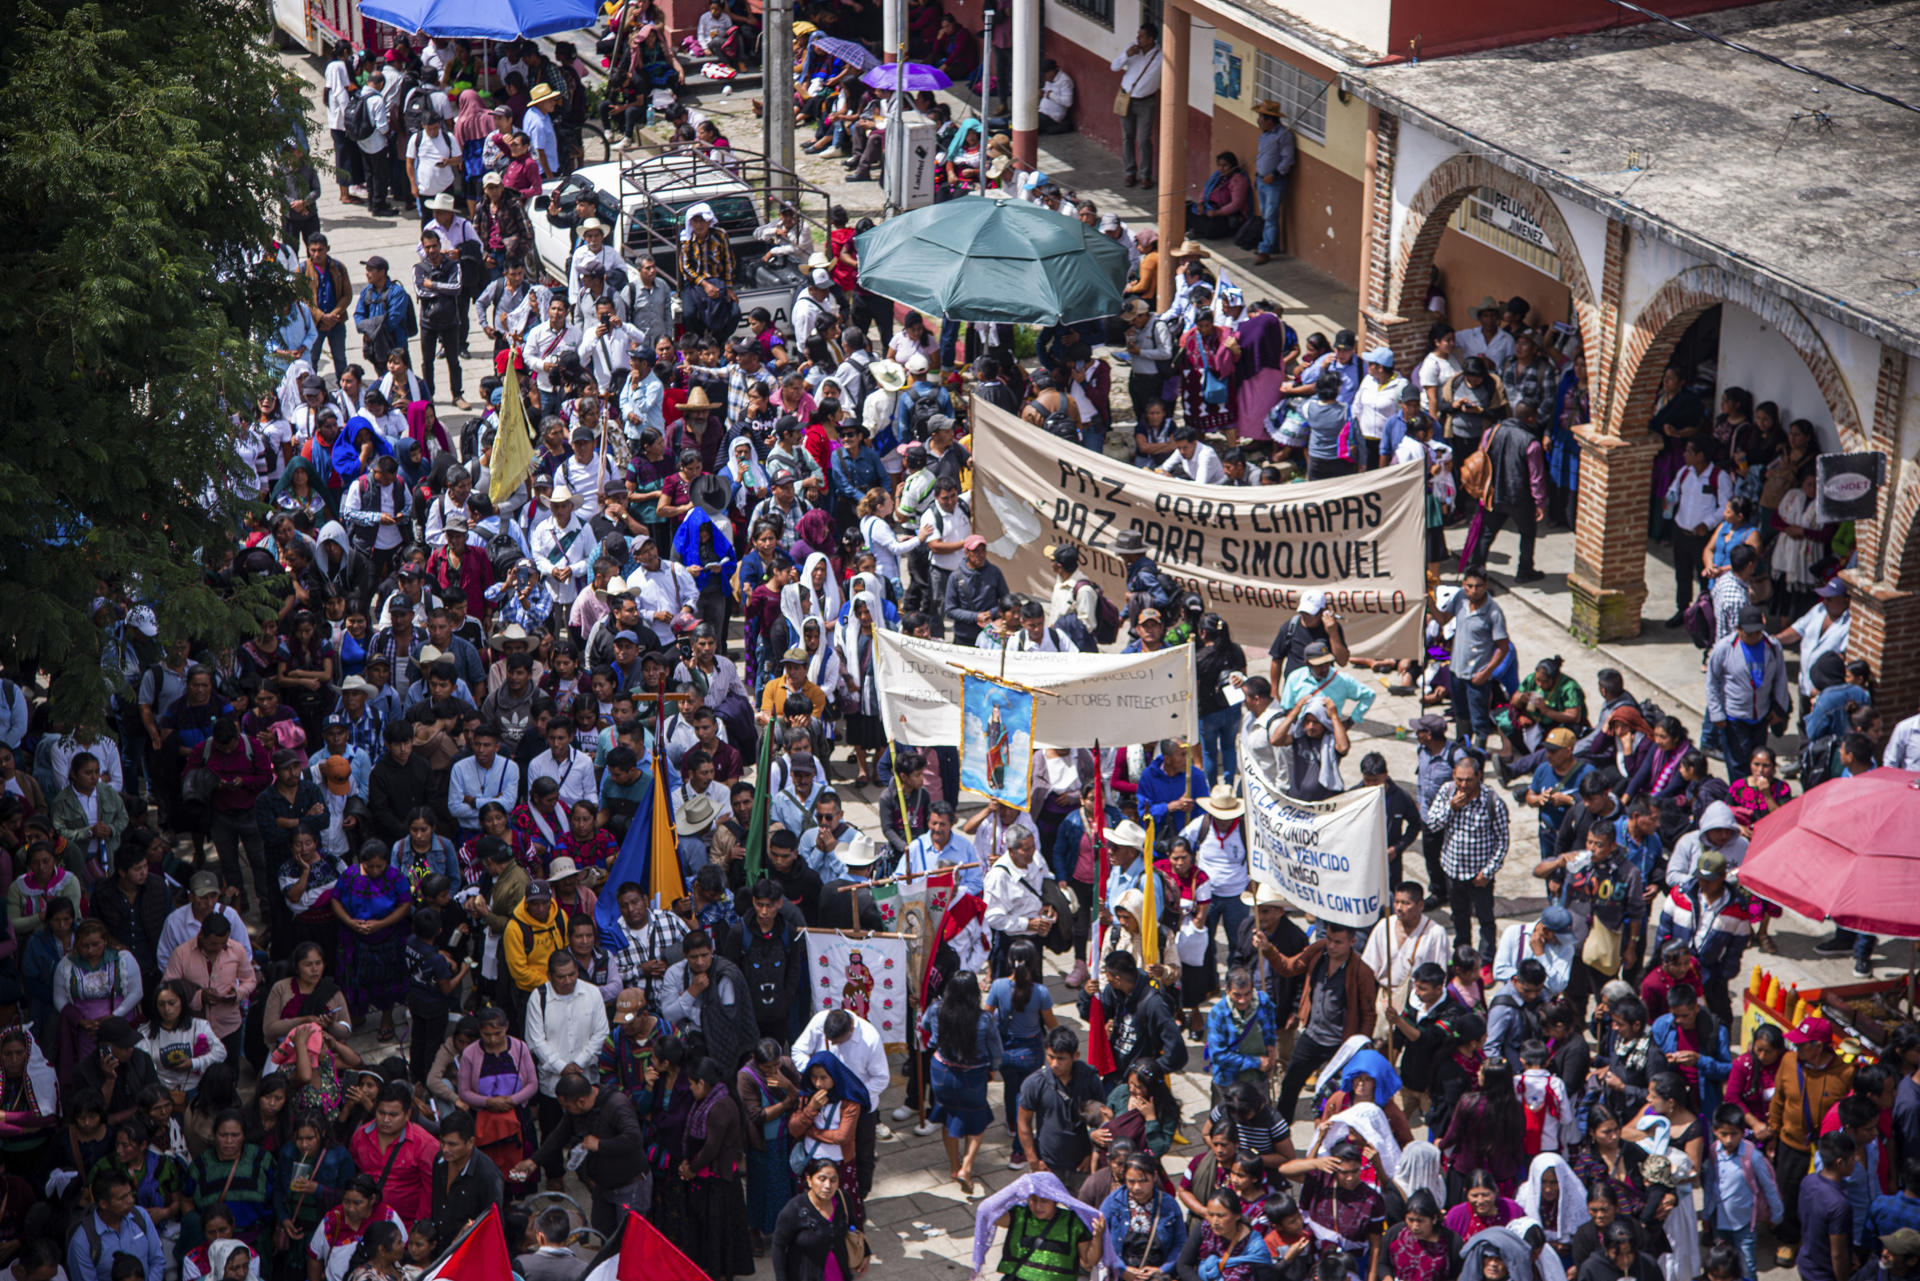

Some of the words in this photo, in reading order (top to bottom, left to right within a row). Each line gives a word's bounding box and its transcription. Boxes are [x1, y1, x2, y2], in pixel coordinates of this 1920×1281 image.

[1058, 459, 1131, 507] PAZ
[1155, 492, 1239, 531] PARA
[1251, 492, 1382, 533] CHIAPAS
[1053, 498, 1117, 548] PAZ
[1221, 537, 1392, 579] SIMOJOVEL
[1207, 580, 1231, 603] EL
[1233, 584, 1297, 610] PADRE
[1322, 590, 1406, 614] ARCELO
[1056, 693, 1111, 708] ACTORES
[1283, 825, 1319, 846] UNIDO
[1294, 846, 1350, 872] VENCIDO
[1252, 850, 1267, 871] EL
[1295, 883, 1325, 907] ESTA
[1287, 863, 1319, 887] AMIGO
